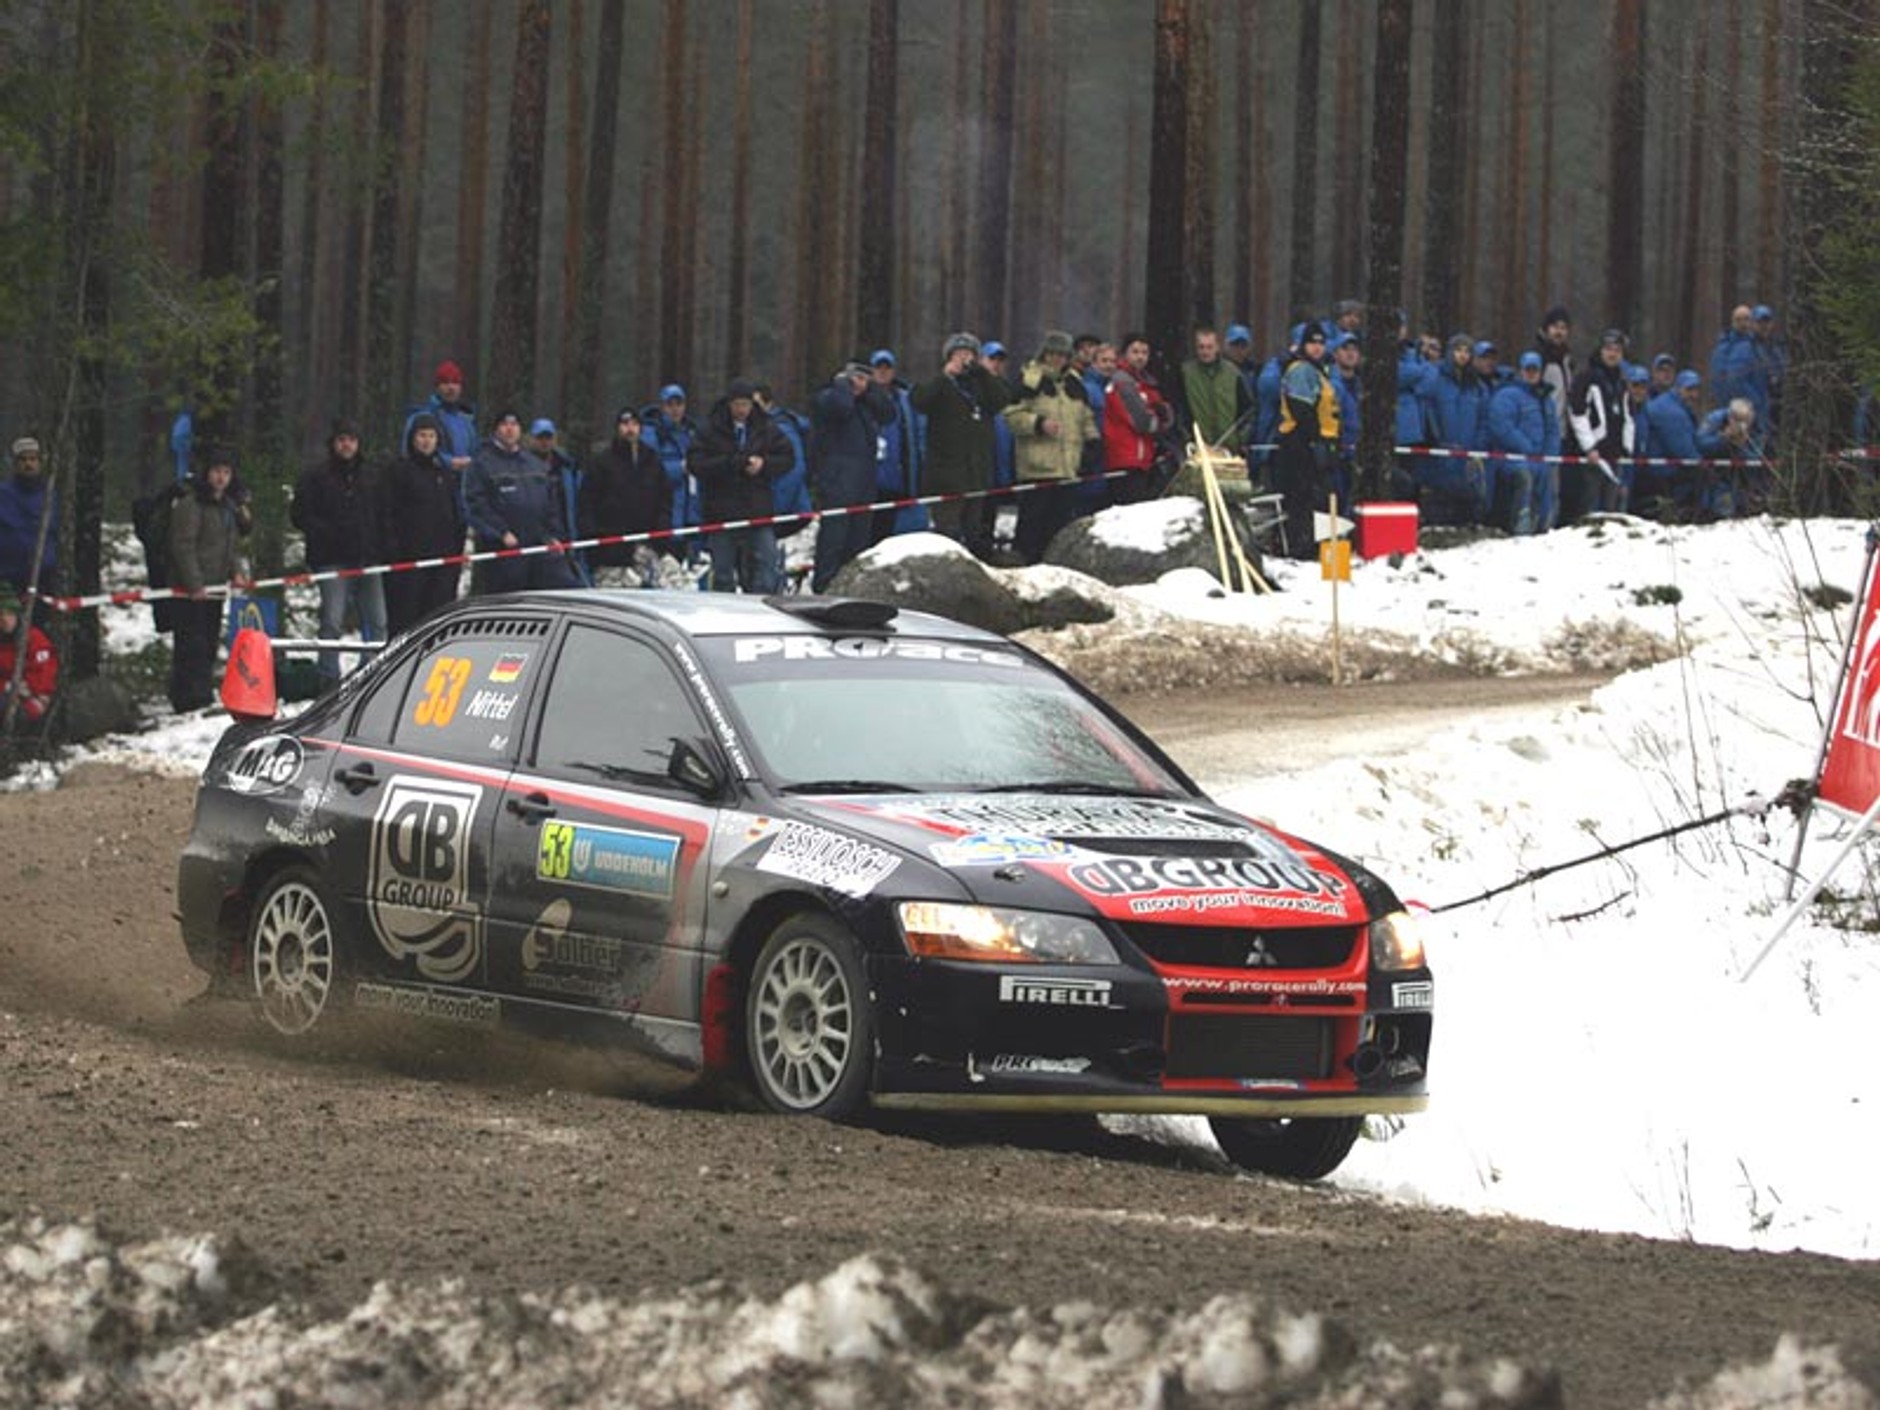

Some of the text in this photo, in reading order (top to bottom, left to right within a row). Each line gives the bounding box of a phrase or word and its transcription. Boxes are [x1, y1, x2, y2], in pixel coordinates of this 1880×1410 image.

[414, 657, 473, 728] 53
[541, 823, 574, 879] 53
[383, 879, 454, 910] GROUP
[1000, 975, 1113, 1006] PIRELLI
